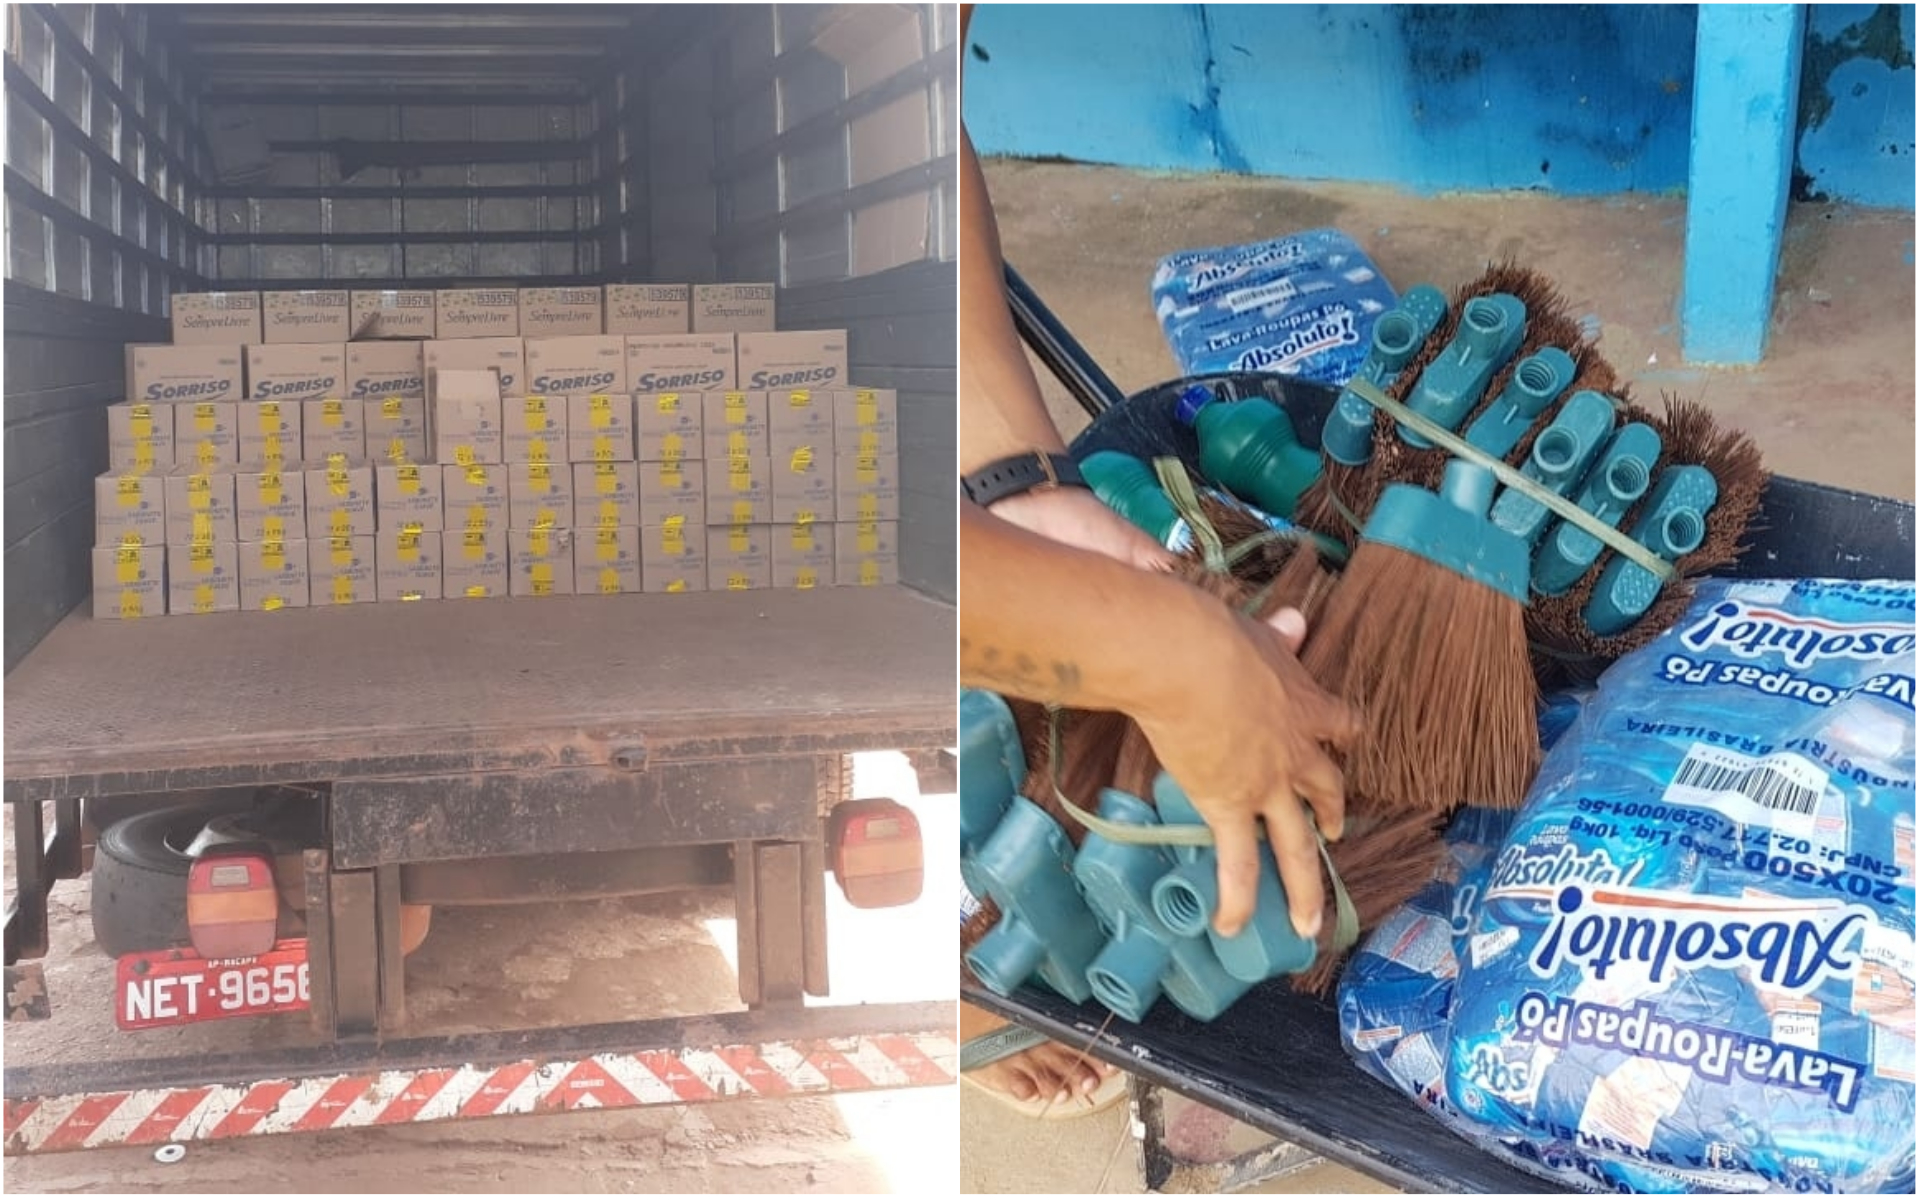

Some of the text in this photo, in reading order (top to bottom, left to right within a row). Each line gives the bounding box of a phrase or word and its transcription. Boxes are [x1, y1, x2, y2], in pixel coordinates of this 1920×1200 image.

[1236, 316, 1357, 371] Absoluto!
[145, 379, 231, 401] SORRISO
[254, 376, 335, 400] SORRISO
[531, 371, 616, 394] SORRISO
[636, 368, 726, 392] SORRISO
[749, 365, 838, 390] SORRISO
[1689, 603, 1916, 663] bsoluto!
[1665, 655, 1714, 688] Pó
[1567, 815, 1620, 840] 10kg
[1678, 833, 1736, 863] Peso
[1819, 844, 1902, 879] CNPJ:
[1743, 849, 1899, 906] 20X500
[1535, 887, 1868, 989] Absoluto!
[1519, 997, 1570, 1044] Pó
[1577, 1002, 1857, 1109] Lava-Roupas
